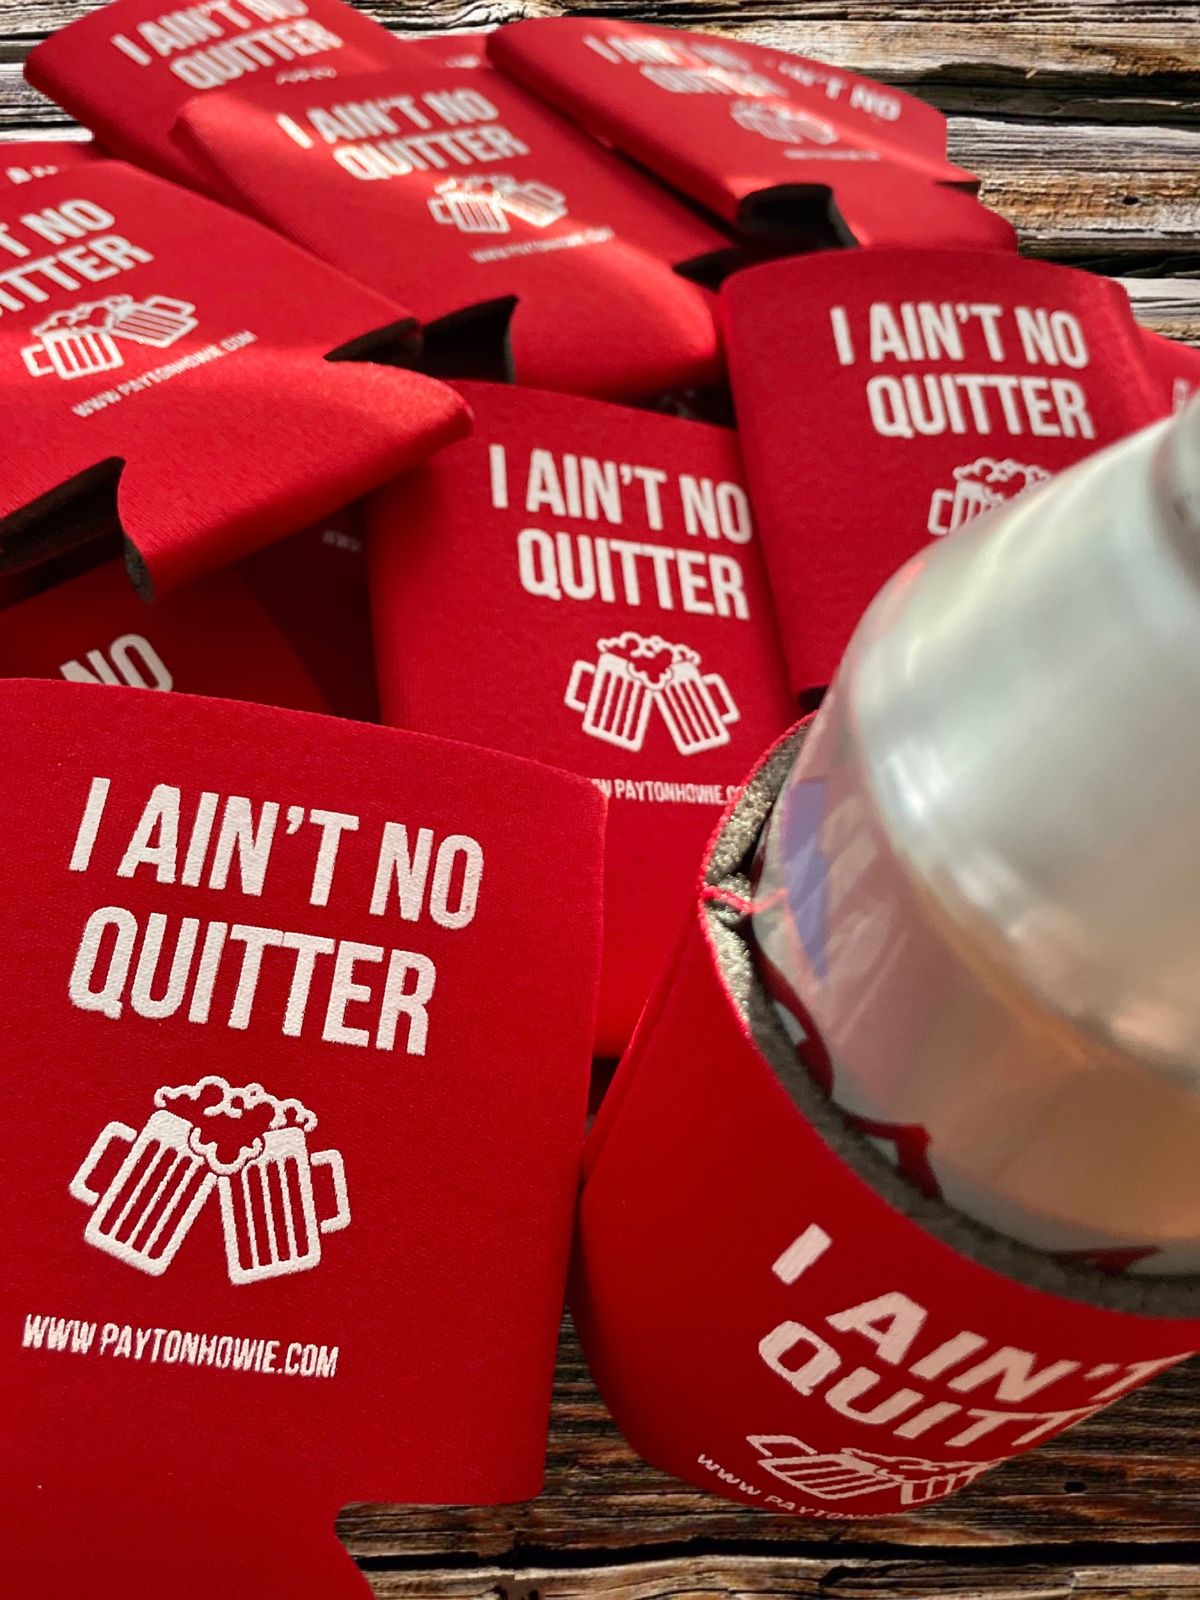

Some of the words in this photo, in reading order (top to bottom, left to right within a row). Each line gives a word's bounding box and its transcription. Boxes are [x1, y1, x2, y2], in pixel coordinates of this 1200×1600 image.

[111, 33, 152, 66] I
[169, 18, 343, 89] QUITTER
[275, 112, 314, 149] I
[307, 95, 432, 144] AIN'T
[421, 88, 499, 125] NO
[332, 125, 530, 180] QUITTER
[19, 199, 116, 245] NO
[0, 234, 155, 312] ITTER
[829, 306, 855, 366] I
[869, 301, 1004, 363] AIN'T
[1014, 306, 1090, 369] NO
[866, 373, 1095, 440] QUITTER
[489, 443, 508, 509] I
[525, 448, 668, 531] AIN'T
[678, 474, 752, 544] NO
[516, 528, 750, 620] QUITTER
[68, 776, 111, 872] I
[116, 783, 360, 907] AIN'T
[369, 821, 485, 930] NO
[68, 906, 437, 1056] QUITTER
[771, 1223, 832, 1285] I
[825, 1291, 1197, 1403] AIN'T
[758, 1320, 1106, 1447] QUITT
